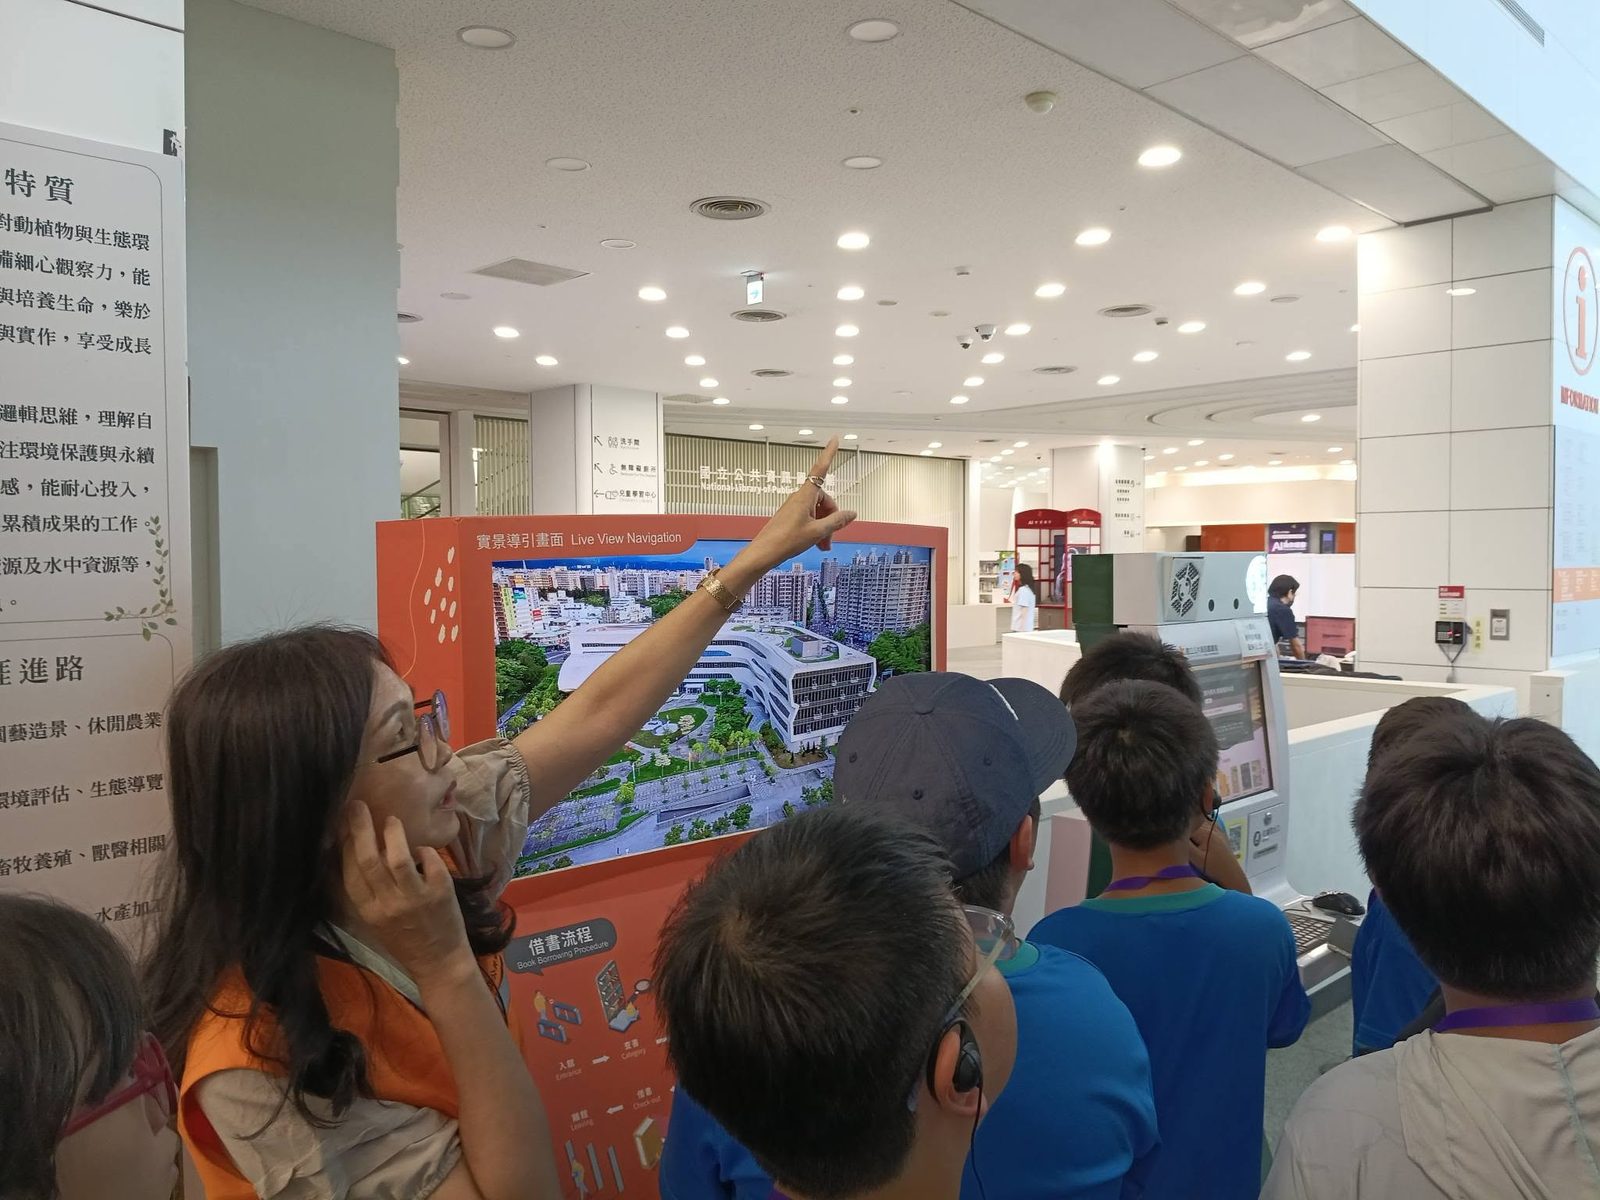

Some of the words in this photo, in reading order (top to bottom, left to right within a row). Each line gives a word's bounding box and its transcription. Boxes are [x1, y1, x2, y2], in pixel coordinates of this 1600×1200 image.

[5, 168, 74, 205] 特質
[0, 441, 155, 464] 注環境保護與永續
[477, 532, 564, 550] 實景導引畫面
[571, 533, 595, 545] Live
[597, 533, 624, 544] View
[627, 532, 682, 546] Navigation
[0, 556, 151, 575] 源及水中資源等，
[529, 926, 593, 956] 借書流程
[517, 959, 536, 970] Book
[537, 950, 573, 964] Borrowing
[574, 941, 609, 955] Procedure
